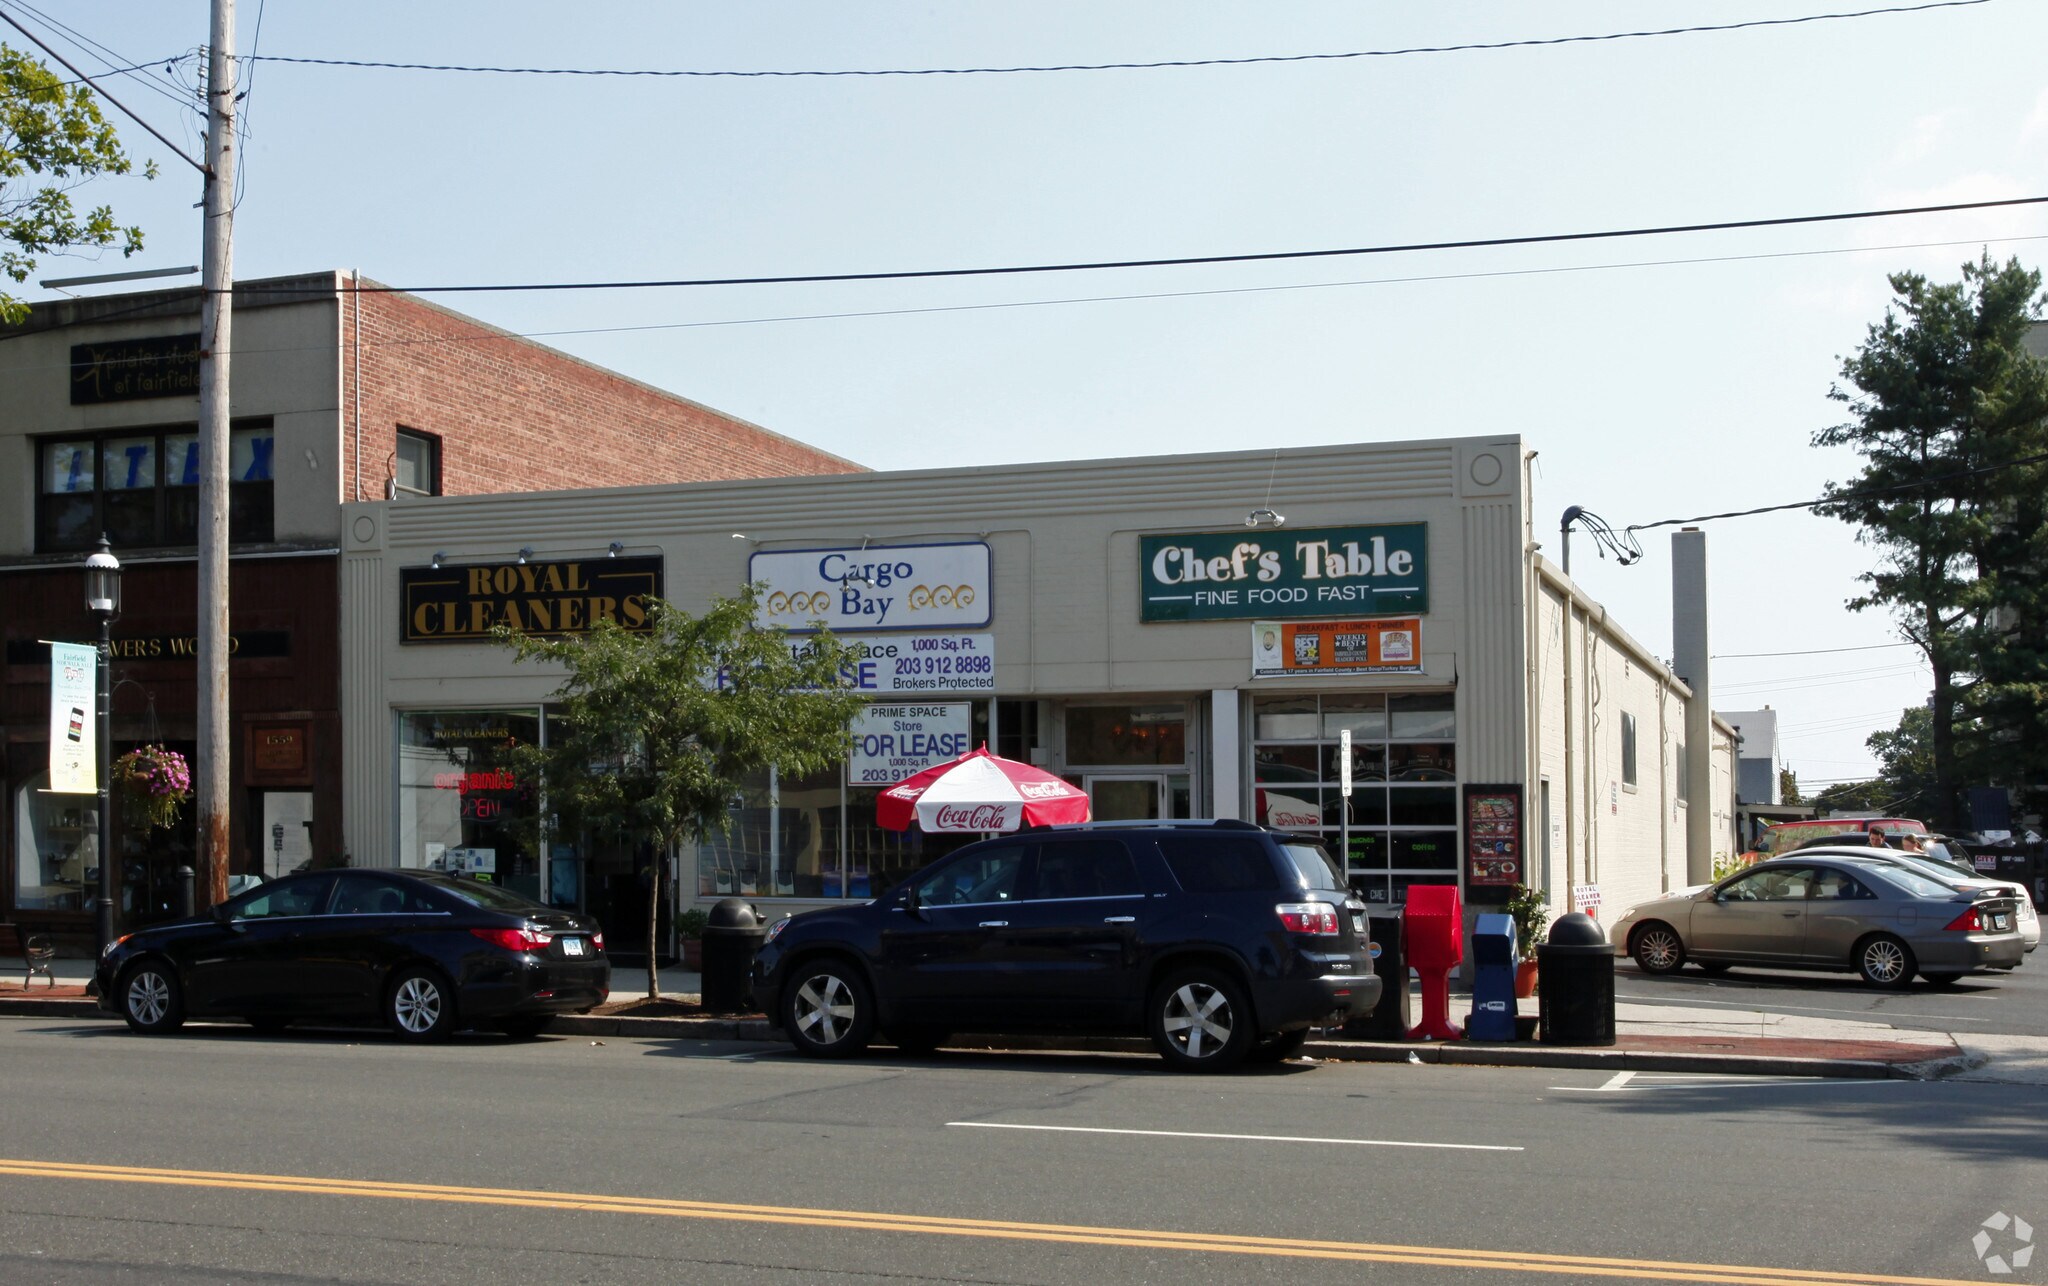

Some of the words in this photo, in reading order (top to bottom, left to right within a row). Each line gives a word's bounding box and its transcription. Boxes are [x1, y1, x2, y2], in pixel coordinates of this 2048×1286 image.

[1152, 542, 1282, 585] Chef's
[1296, 536, 1414, 580] Table
[467, 563, 589, 596] ROYAL
[818, 553, 914, 588] Cargo
[1195, 589, 1239, 606] FINE
[1247, 587, 1308, 604] FOOD
[1318, 585, 1370, 601] FAST
[414, 594, 647, 635] CLEANERS
[841, 588, 894, 625] Bay
[1296, 623, 1339, 632] BREAKFAST
[1345, 622, 1371, 631] LUNCH
[1377, 621, 1406, 630] DINNER
[911, 638, 939, 652] 1,000
[941, 638, 959, 653] Sq.
[962, 637, 976, 649] Ft.
[1295, 637, 1319, 649] BEST
[895, 657, 922, 675] 203
[925, 656, 952, 674] 912
[955, 655, 991, 673] 8898
[893, 677, 936, 689] Brokers
[939, 675, 994, 688] Protected
[871, 707, 906, 717] PRIME
[909, 706, 947, 717] SPACE
[464, 727, 509, 738] CLEANERS
[893, 720, 922, 731] Store
[266, 735, 293, 745] 1559
[852, 733, 895, 757] FOR
[900, 733, 967, 757] LEASE
[889, 758, 907, 766] 1,000
[908, 757, 920, 767] Sq.
[921, 758, 931, 766] Ft.
[434, 768, 516, 795] organic
[862, 769, 888, 781] 203
[1020, 780, 1069, 798] Coca-Cola
[936, 804, 1007, 829] Coca-Cola
